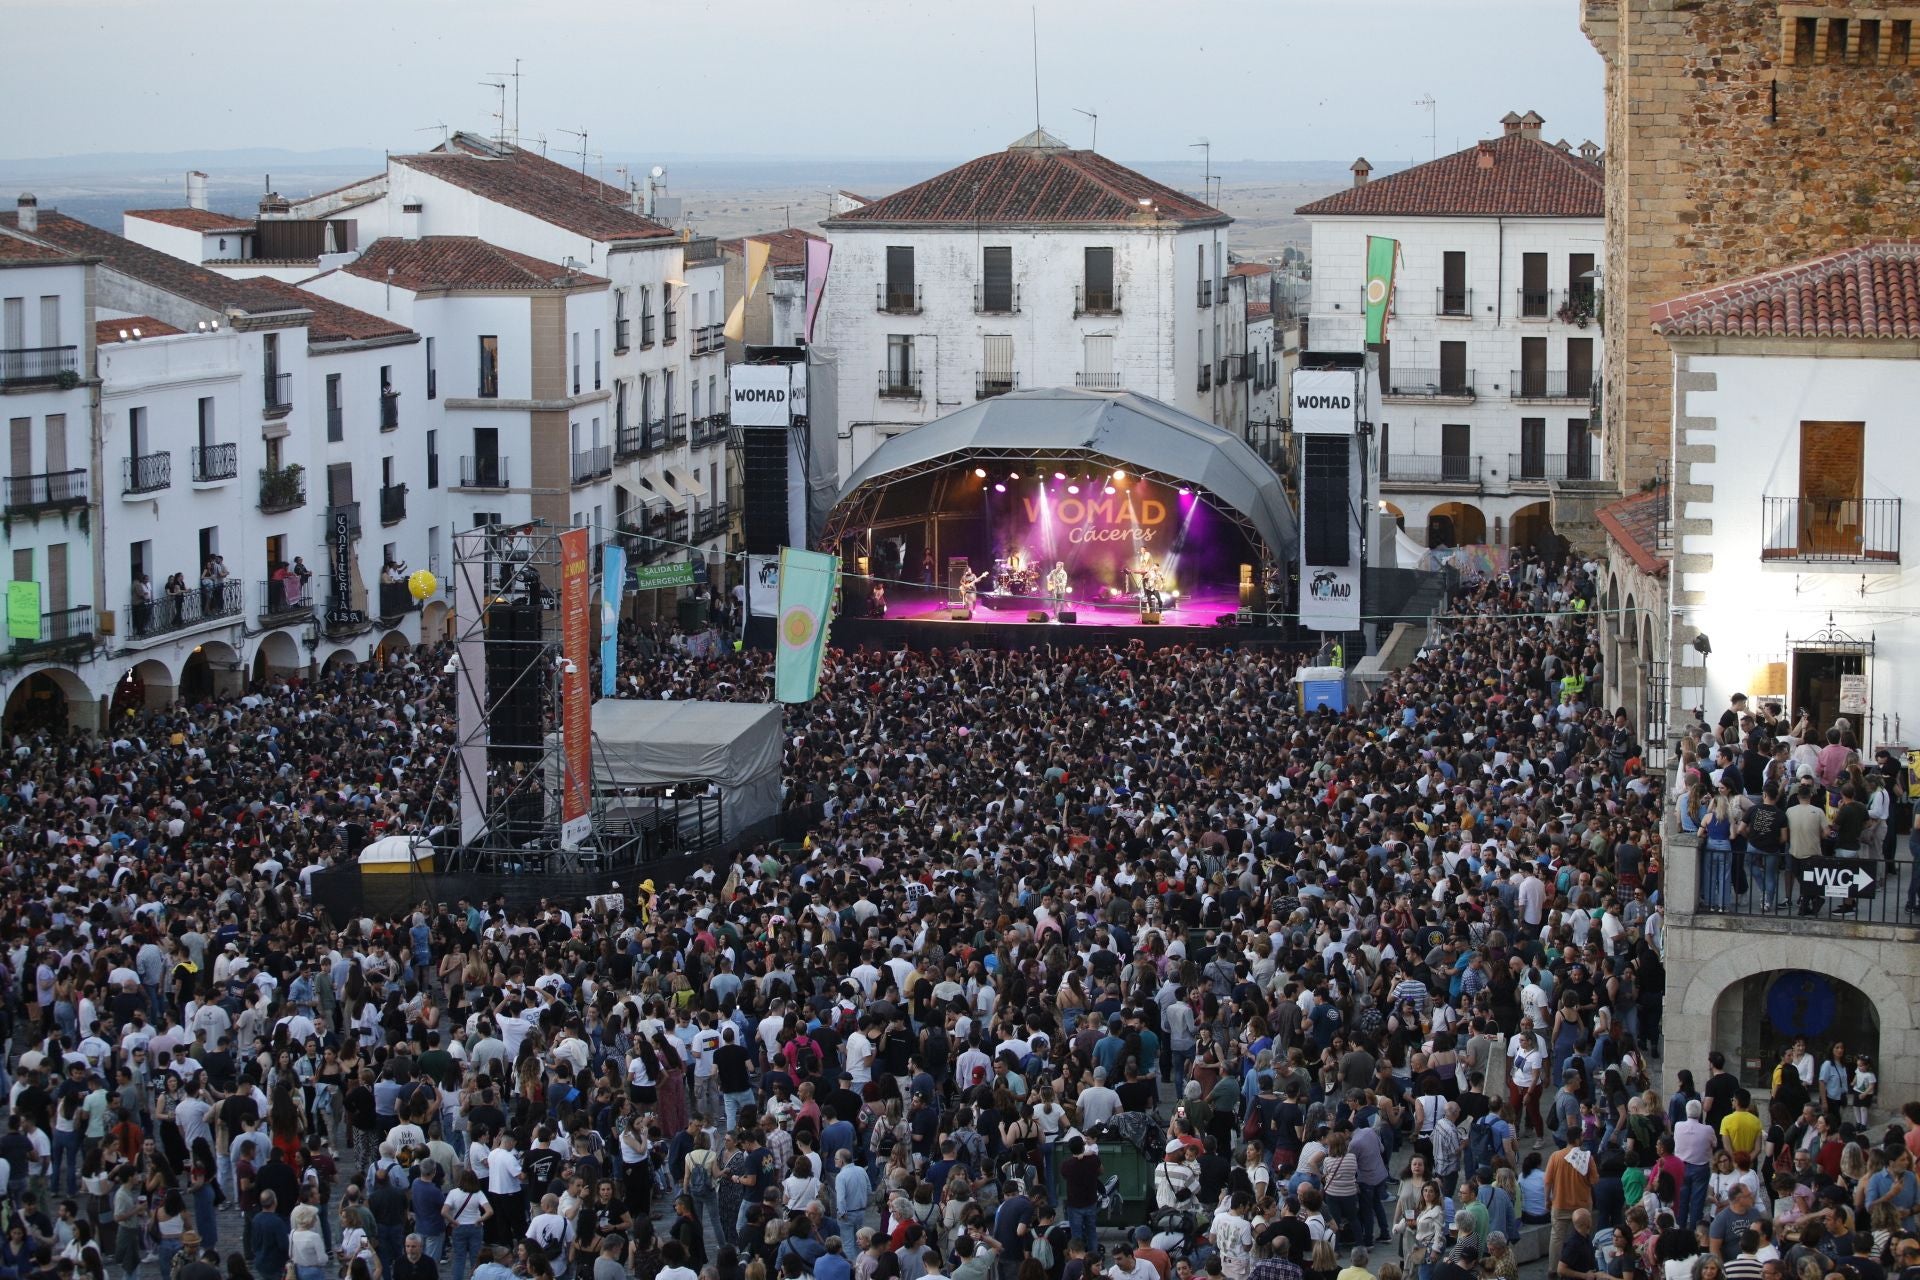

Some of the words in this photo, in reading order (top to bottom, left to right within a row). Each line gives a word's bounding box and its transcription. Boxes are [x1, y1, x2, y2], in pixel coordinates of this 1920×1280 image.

[734, 388, 785, 403] WOMAD
[1297, 395, 1351, 409] WOMAD
[1022, 498, 1166, 525] WOMAD
[1068, 525, 1157, 544] Cáceres
[644, 565, 672, 575] SALIDA
[673, 563, 685, 573] DE
[640, 575, 692, 587] EMERGENCIA
[1814, 867, 1854, 887] WC
